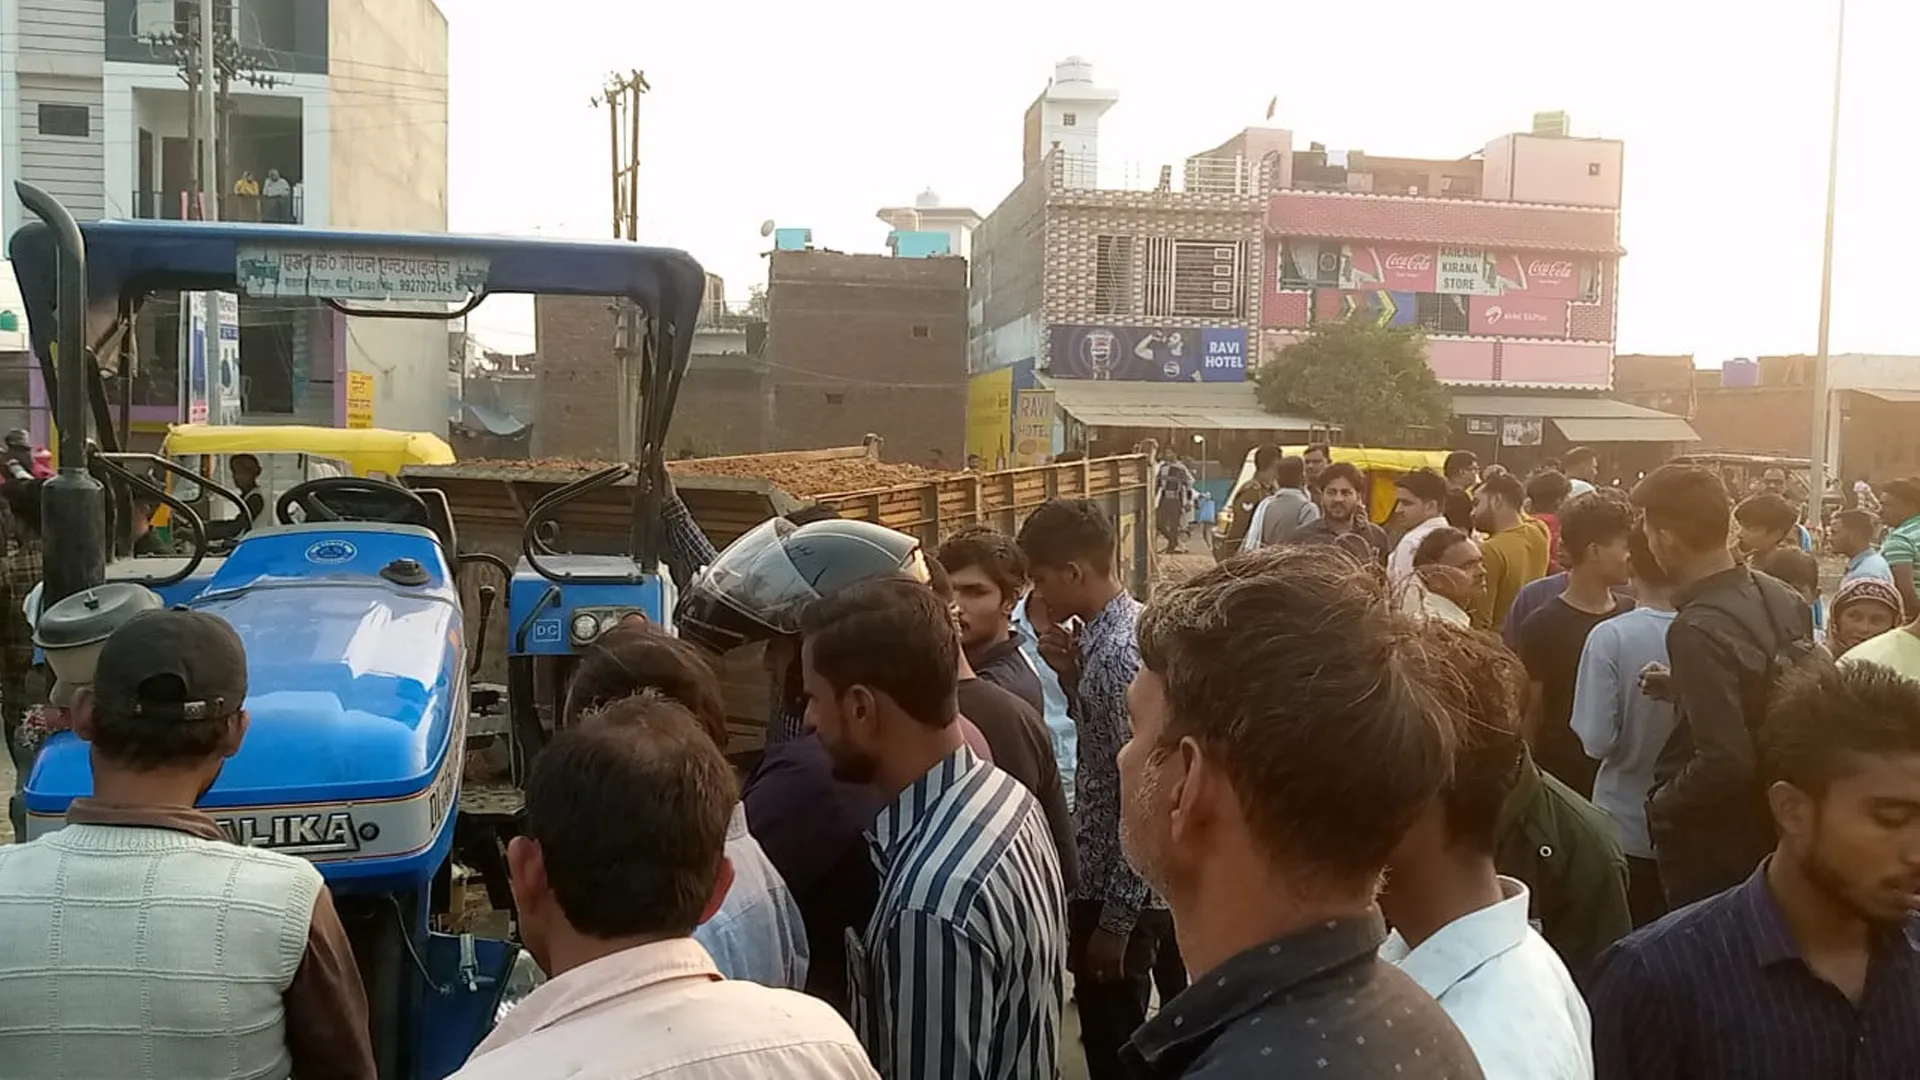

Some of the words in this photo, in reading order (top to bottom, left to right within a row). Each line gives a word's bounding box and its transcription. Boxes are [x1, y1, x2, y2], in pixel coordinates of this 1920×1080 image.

[1442, 262, 1479, 274] KIRANA
[1443, 277, 1475, 290] STORE
[1209, 342, 1240, 354] RAVI
[1205, 356, 1244, 369] HOTEL
[1020, 396, 1048, 418] RAVI
[537, 625, 557, 636] DC
